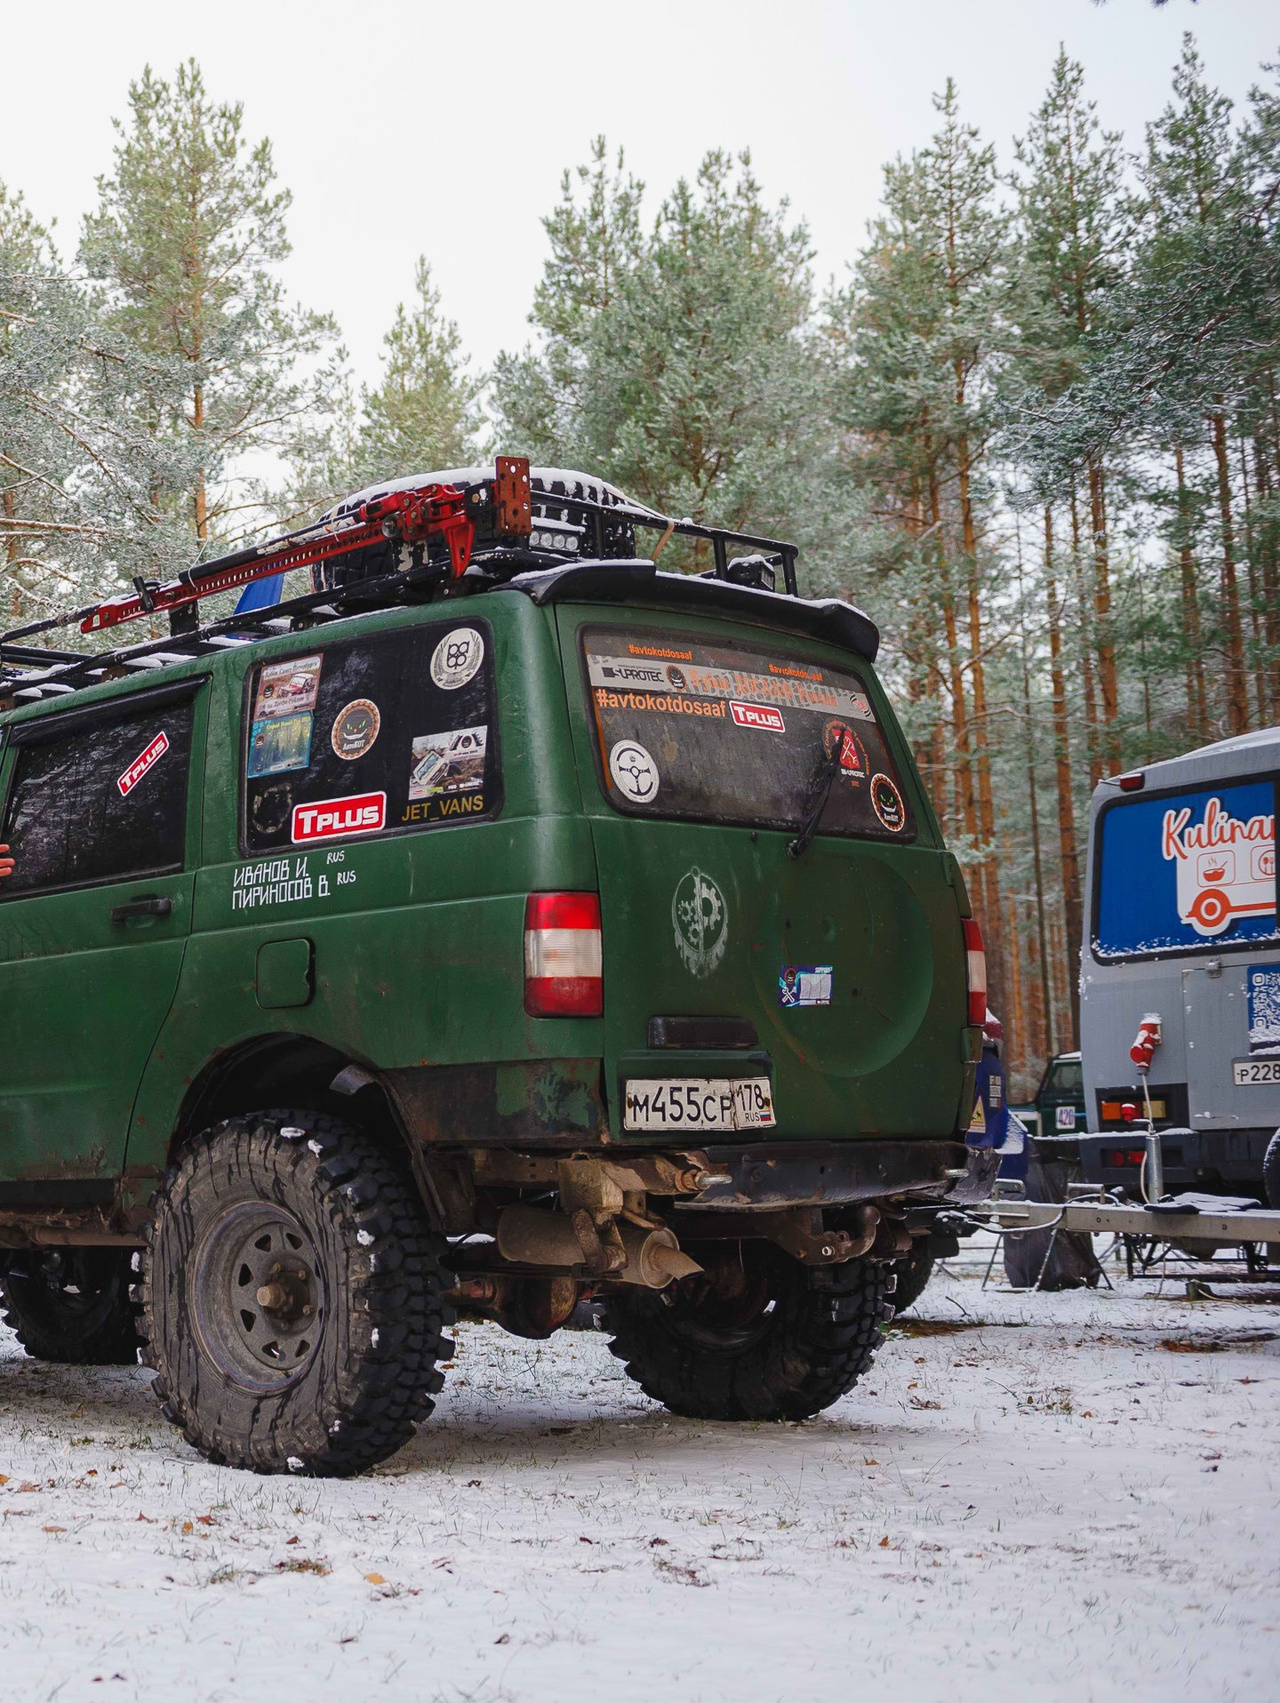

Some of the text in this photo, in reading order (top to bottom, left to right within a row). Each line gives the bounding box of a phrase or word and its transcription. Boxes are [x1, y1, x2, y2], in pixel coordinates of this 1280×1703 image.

[628, 643, 693, 660] #avtokotdosaaf
[614, 667, 665, 683] SUPROTEC
[768, 664, 823, 682] #avtokotdoaaf
[596, 688, 727, 718] #avtokotdosaaf
[733, 705, 782, 728] TPLUS
[121, 739, 166, 788] TPLUS
[298, 805, 380, 835] TPLUS
[401, 794, 484, 821] JET_VANS
[233, 850, 345, 888] ИВАНОВ И. RUS
[232, 870, 357, 910] ПИРИНОСОВ В. RUS
[736, 1084, 765, 1111] 178
[745, 1111, 760, 1123] RUS
